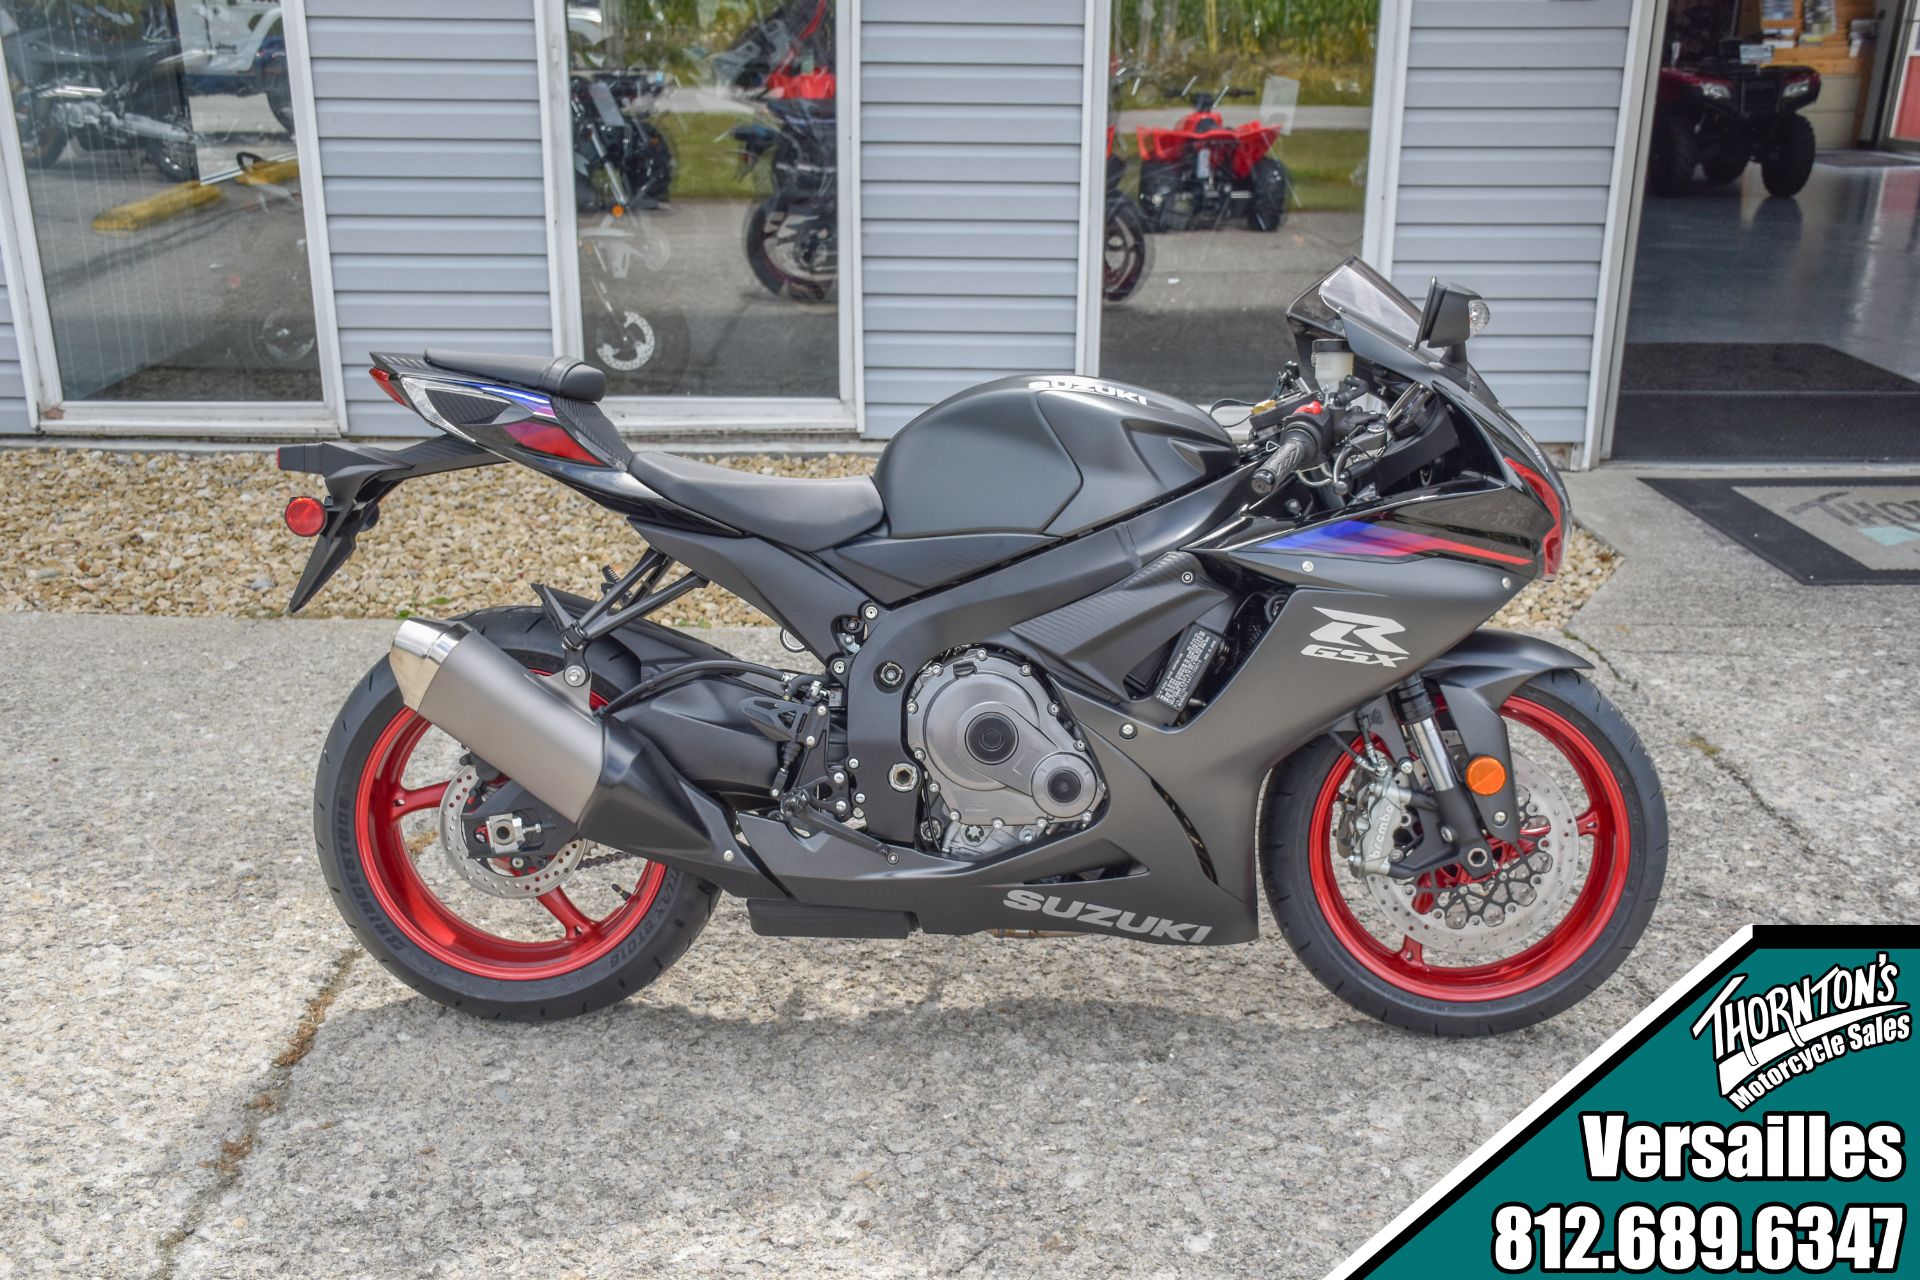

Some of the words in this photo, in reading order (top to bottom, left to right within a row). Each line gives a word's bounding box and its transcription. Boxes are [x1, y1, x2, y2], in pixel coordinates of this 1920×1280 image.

[1028, 377, 1147, 406] SUZUKI
[1368, 805, 1394, 859] brembo
[337, 794, 408, 951] BRIDGESTONE
[1002, 889, 1212, 943] SUZUKI
